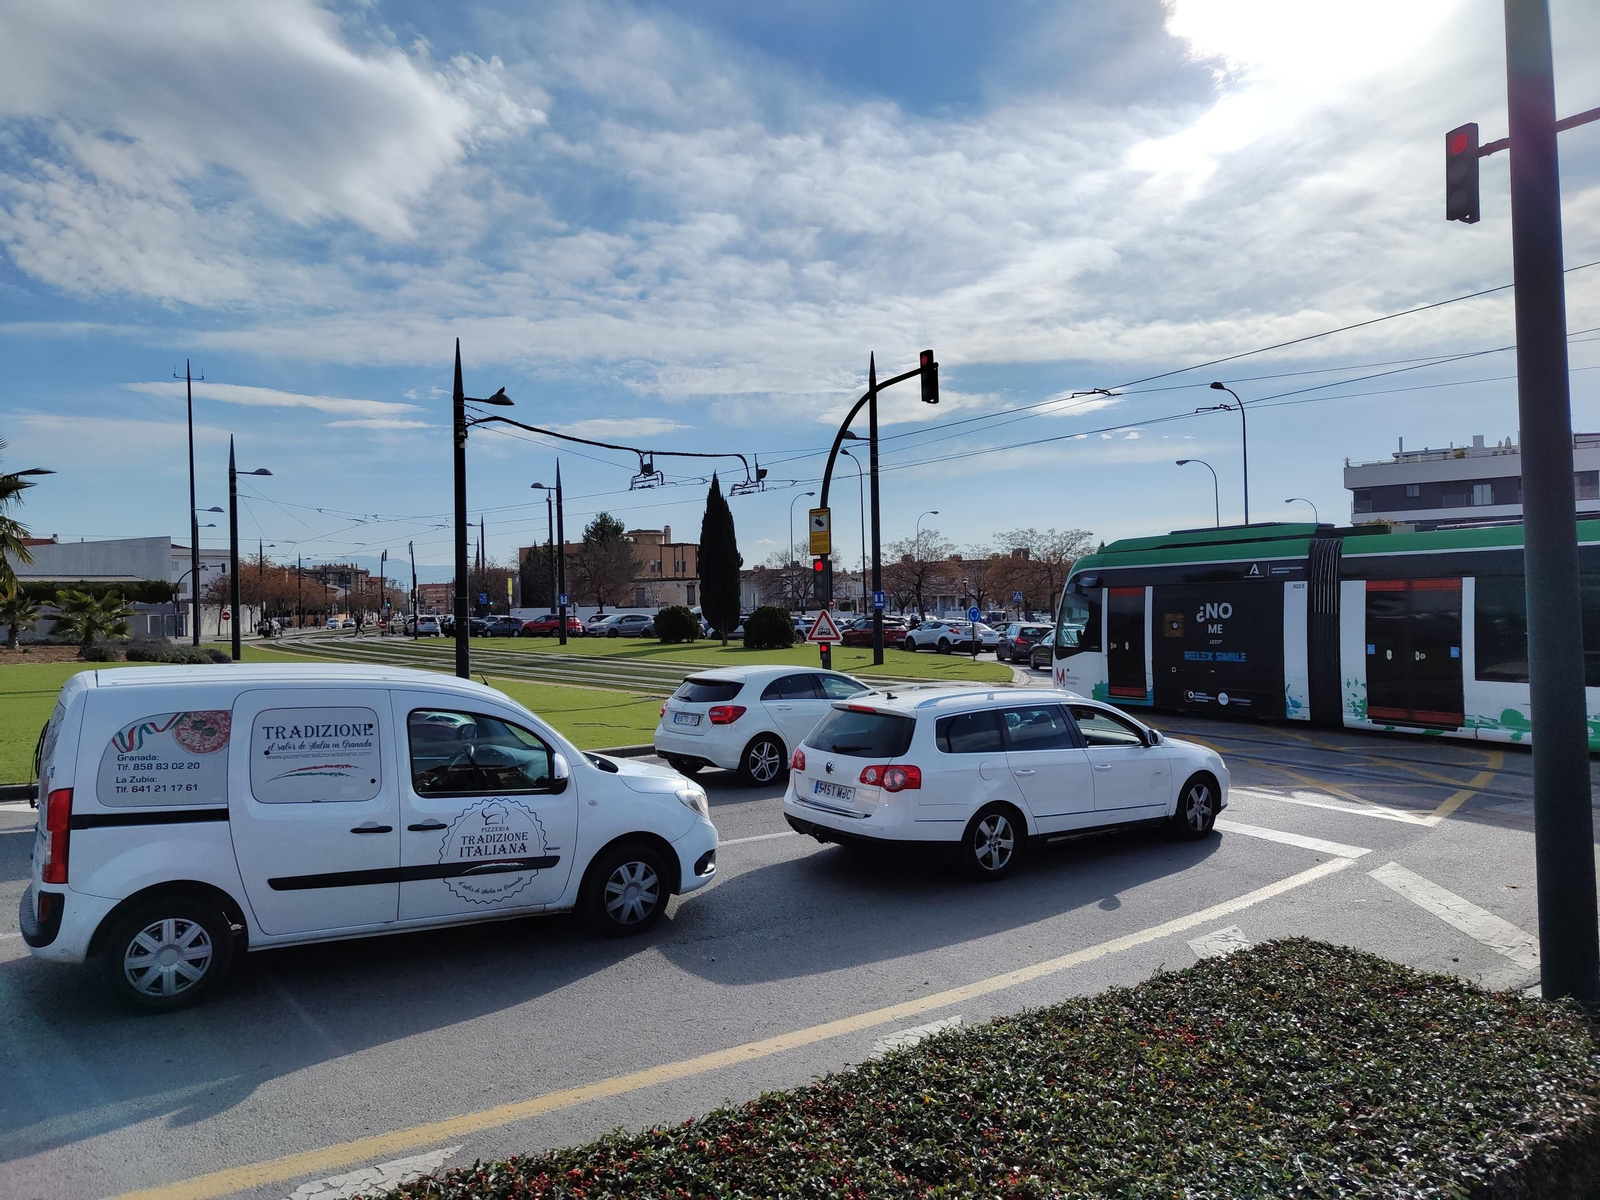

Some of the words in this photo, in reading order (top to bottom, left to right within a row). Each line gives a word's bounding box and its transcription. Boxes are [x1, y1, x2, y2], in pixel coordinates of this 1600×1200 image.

[1196, 602, 1233, 623] ¿NO
[1208, 623, 1223, 634] ME
[262, 723, 374, 740] TRADIZIONE
[297, 741, 306, 750] de
[342, 738, 372, 749] Granada
[117, 754, 159, 762] Granada:
[117, 763, 131, 771] Tlf.
[133, 763, 153, 771] 858
[171, 762, 185, 770] 02
[187, 762, 200, 770] 20
[115, 776, 127, 784] La
[129, 776, 157, 784] Zubia:
[131, 785, 151, 793] 641
[170, 784, 183, 792] 17
[461, 831, 528, 845] TRADIZIONE
[459, 842, 528, 858] ITALIANA
